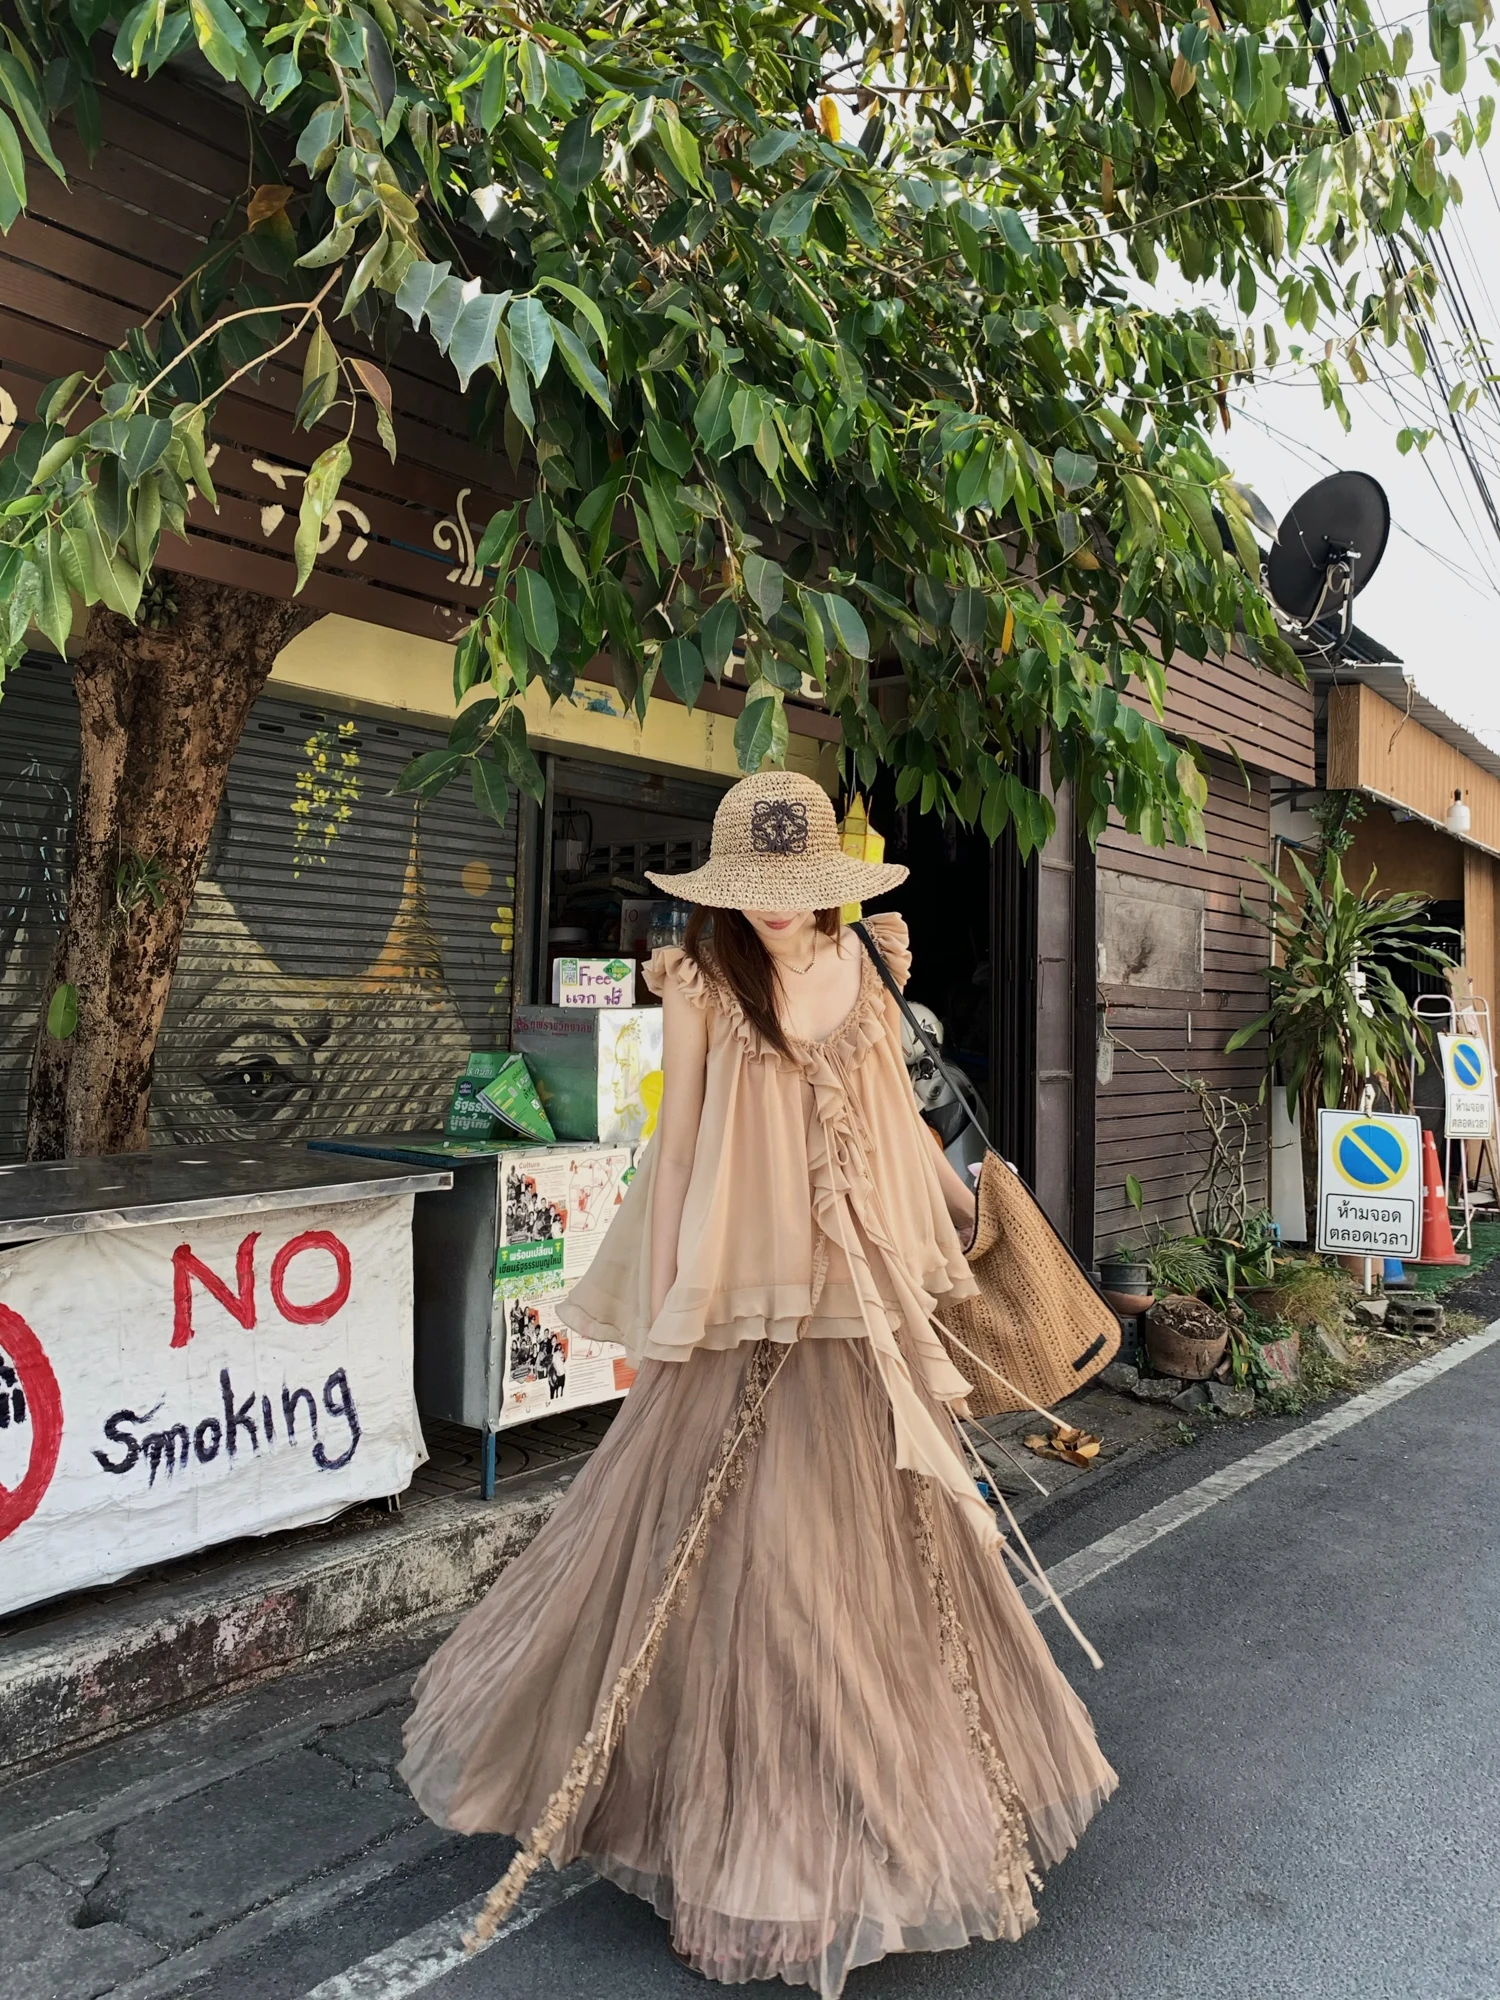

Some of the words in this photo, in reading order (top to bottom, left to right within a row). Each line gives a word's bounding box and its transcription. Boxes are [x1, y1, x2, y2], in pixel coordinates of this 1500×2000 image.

[579, 966, 612, 986] Free
[566, 993, 596, 1005] แจก
[604, 987, 623, 1005] ฟรี
[1452, 1118, 1488, 1129] ตลอดเวลา
[1337, 1200, 1402, 1223] ห้ามจอด
[1329, 1226, 1408, 1247] ตลอดเวลา
[509, 1244, 553, 1261] พร้อมเปลี่ยน
[170, 1230, 352, 1348] NO
[91, 1367, 363, 1488] Smoking
